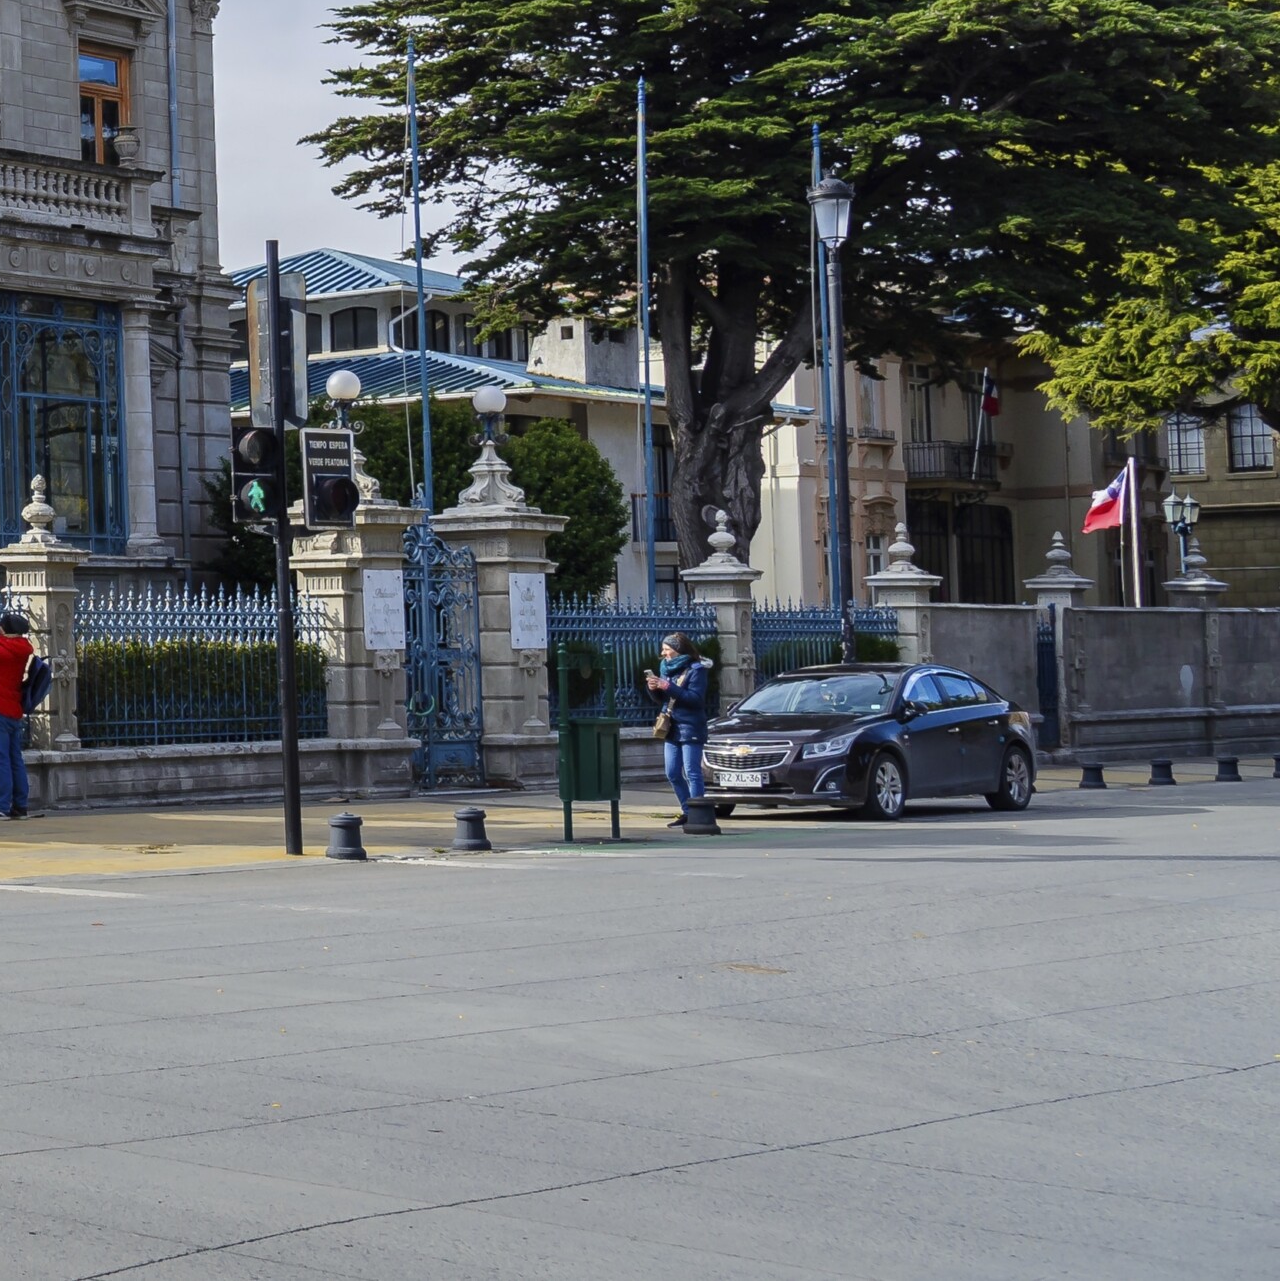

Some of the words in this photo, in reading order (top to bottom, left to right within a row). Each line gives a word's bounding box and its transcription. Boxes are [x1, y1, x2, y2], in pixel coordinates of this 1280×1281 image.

[308, 439, 327, 449] TIEMPO
[329, 440, 348, 449] ESPERA
[308, 457, 324, 467] VERDE
[324, 458, 350, 467] PEATONAL
